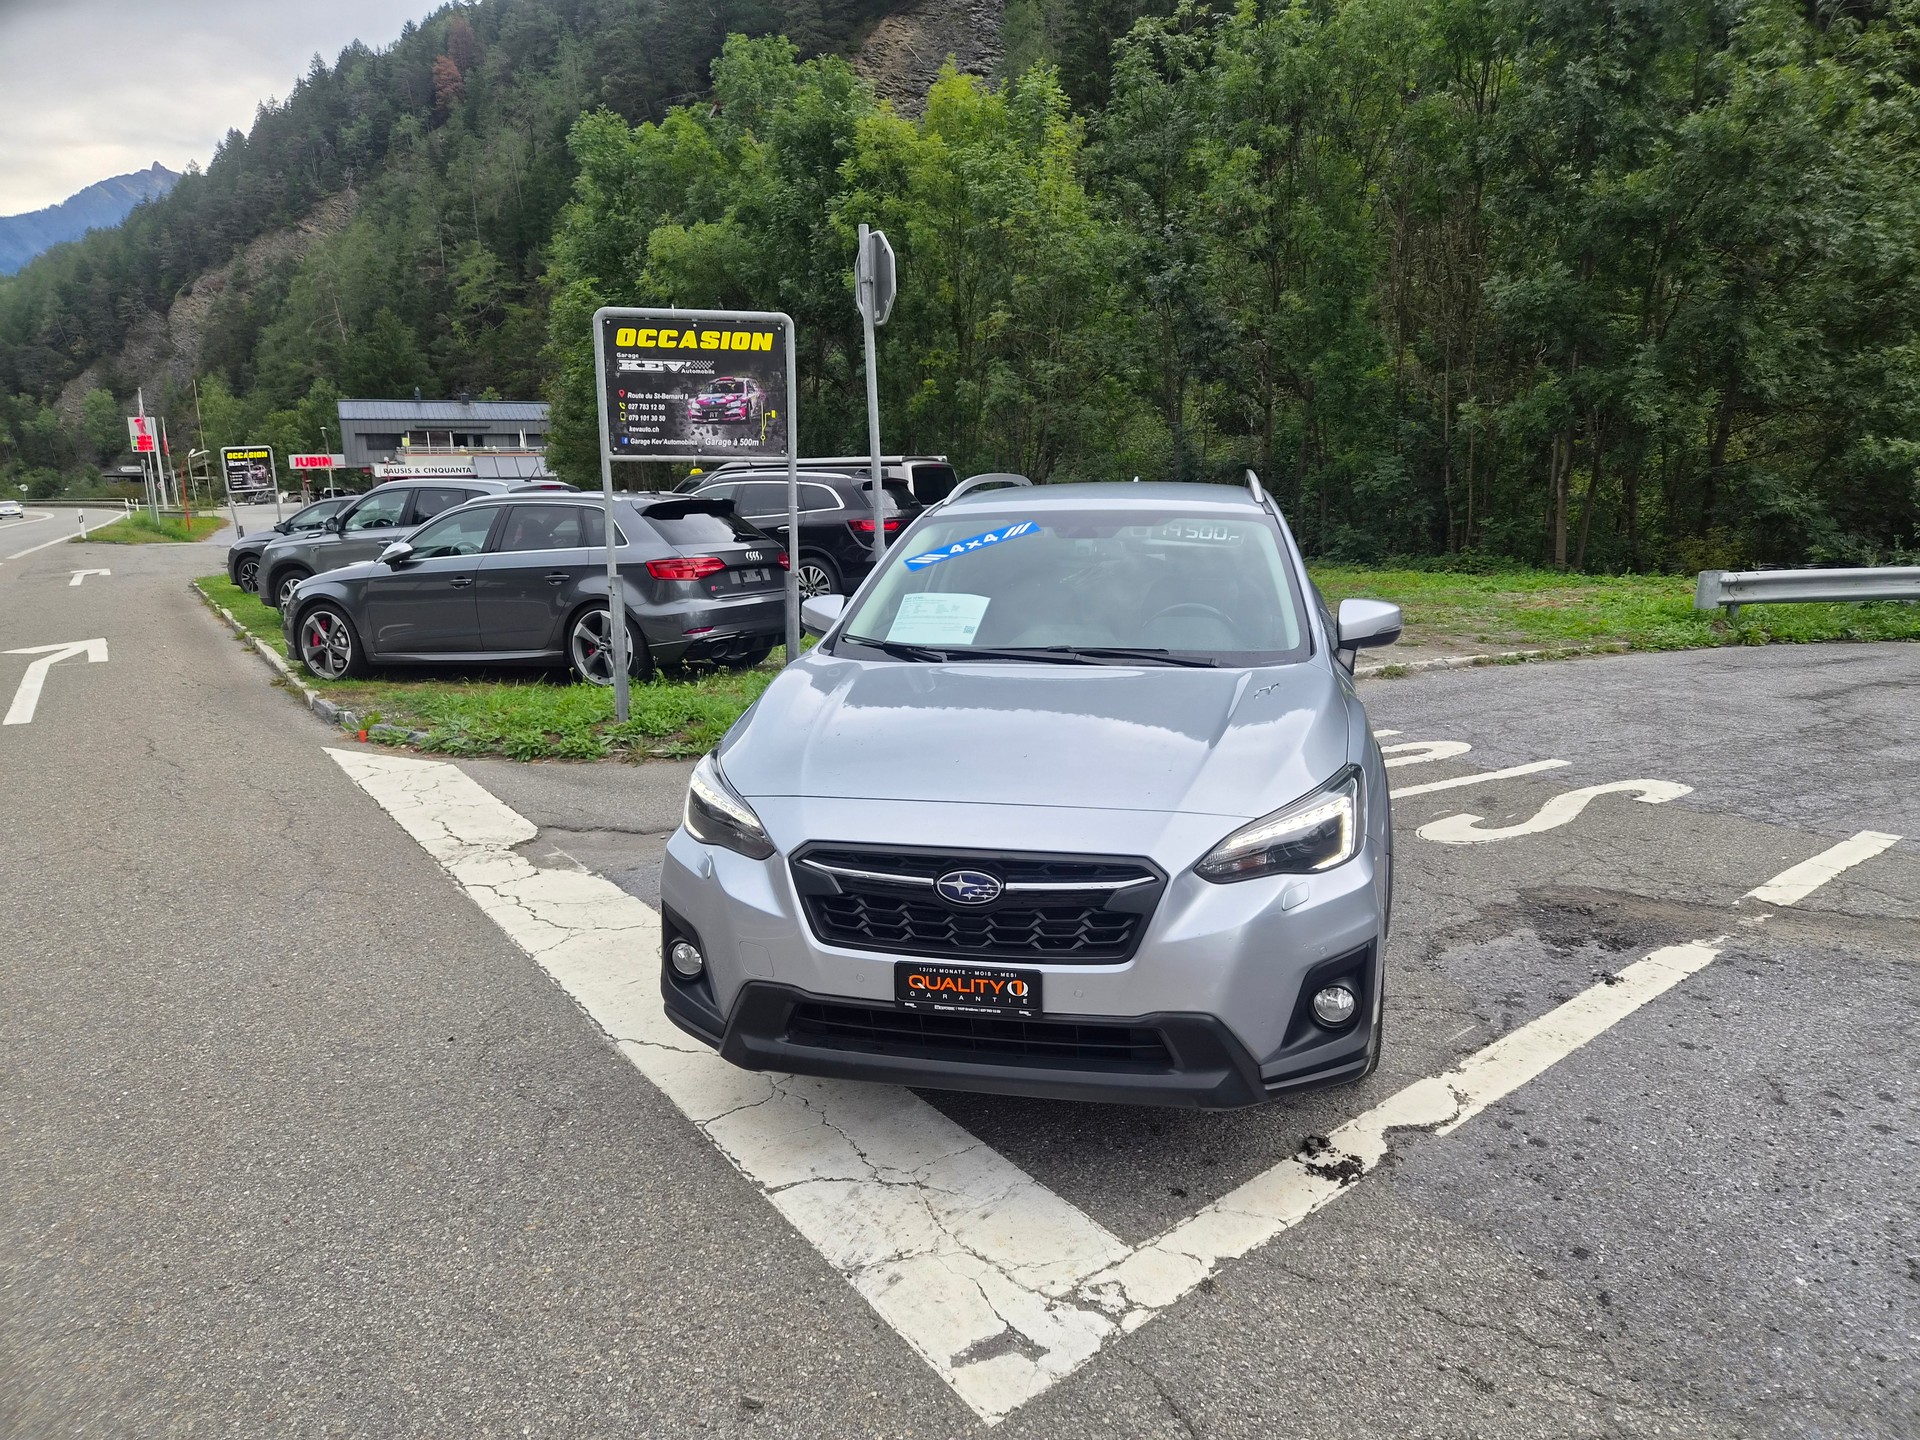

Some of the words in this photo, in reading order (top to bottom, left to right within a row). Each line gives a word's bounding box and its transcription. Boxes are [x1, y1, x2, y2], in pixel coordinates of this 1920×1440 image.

[615, 327, 774, 351] OCCASION
[654, 392, 684, 400] St-Bernard
[629, 425, 660, 433] kevauto.ch
[630, 438, 650, 446] Garage
[705, 437, 732, 447] Garage
[733, 437, 738, 446] à
[740, 438, 759, 446] 500m
[227, 451, 268, 460] OCCASION
[295, 456, 333, 467] JUBIN
[949, 533, 999, 554] 4x4
[908, 974, 1005, 994] QUALITY
[909, 991, 1028, 1005] GARANTIE
